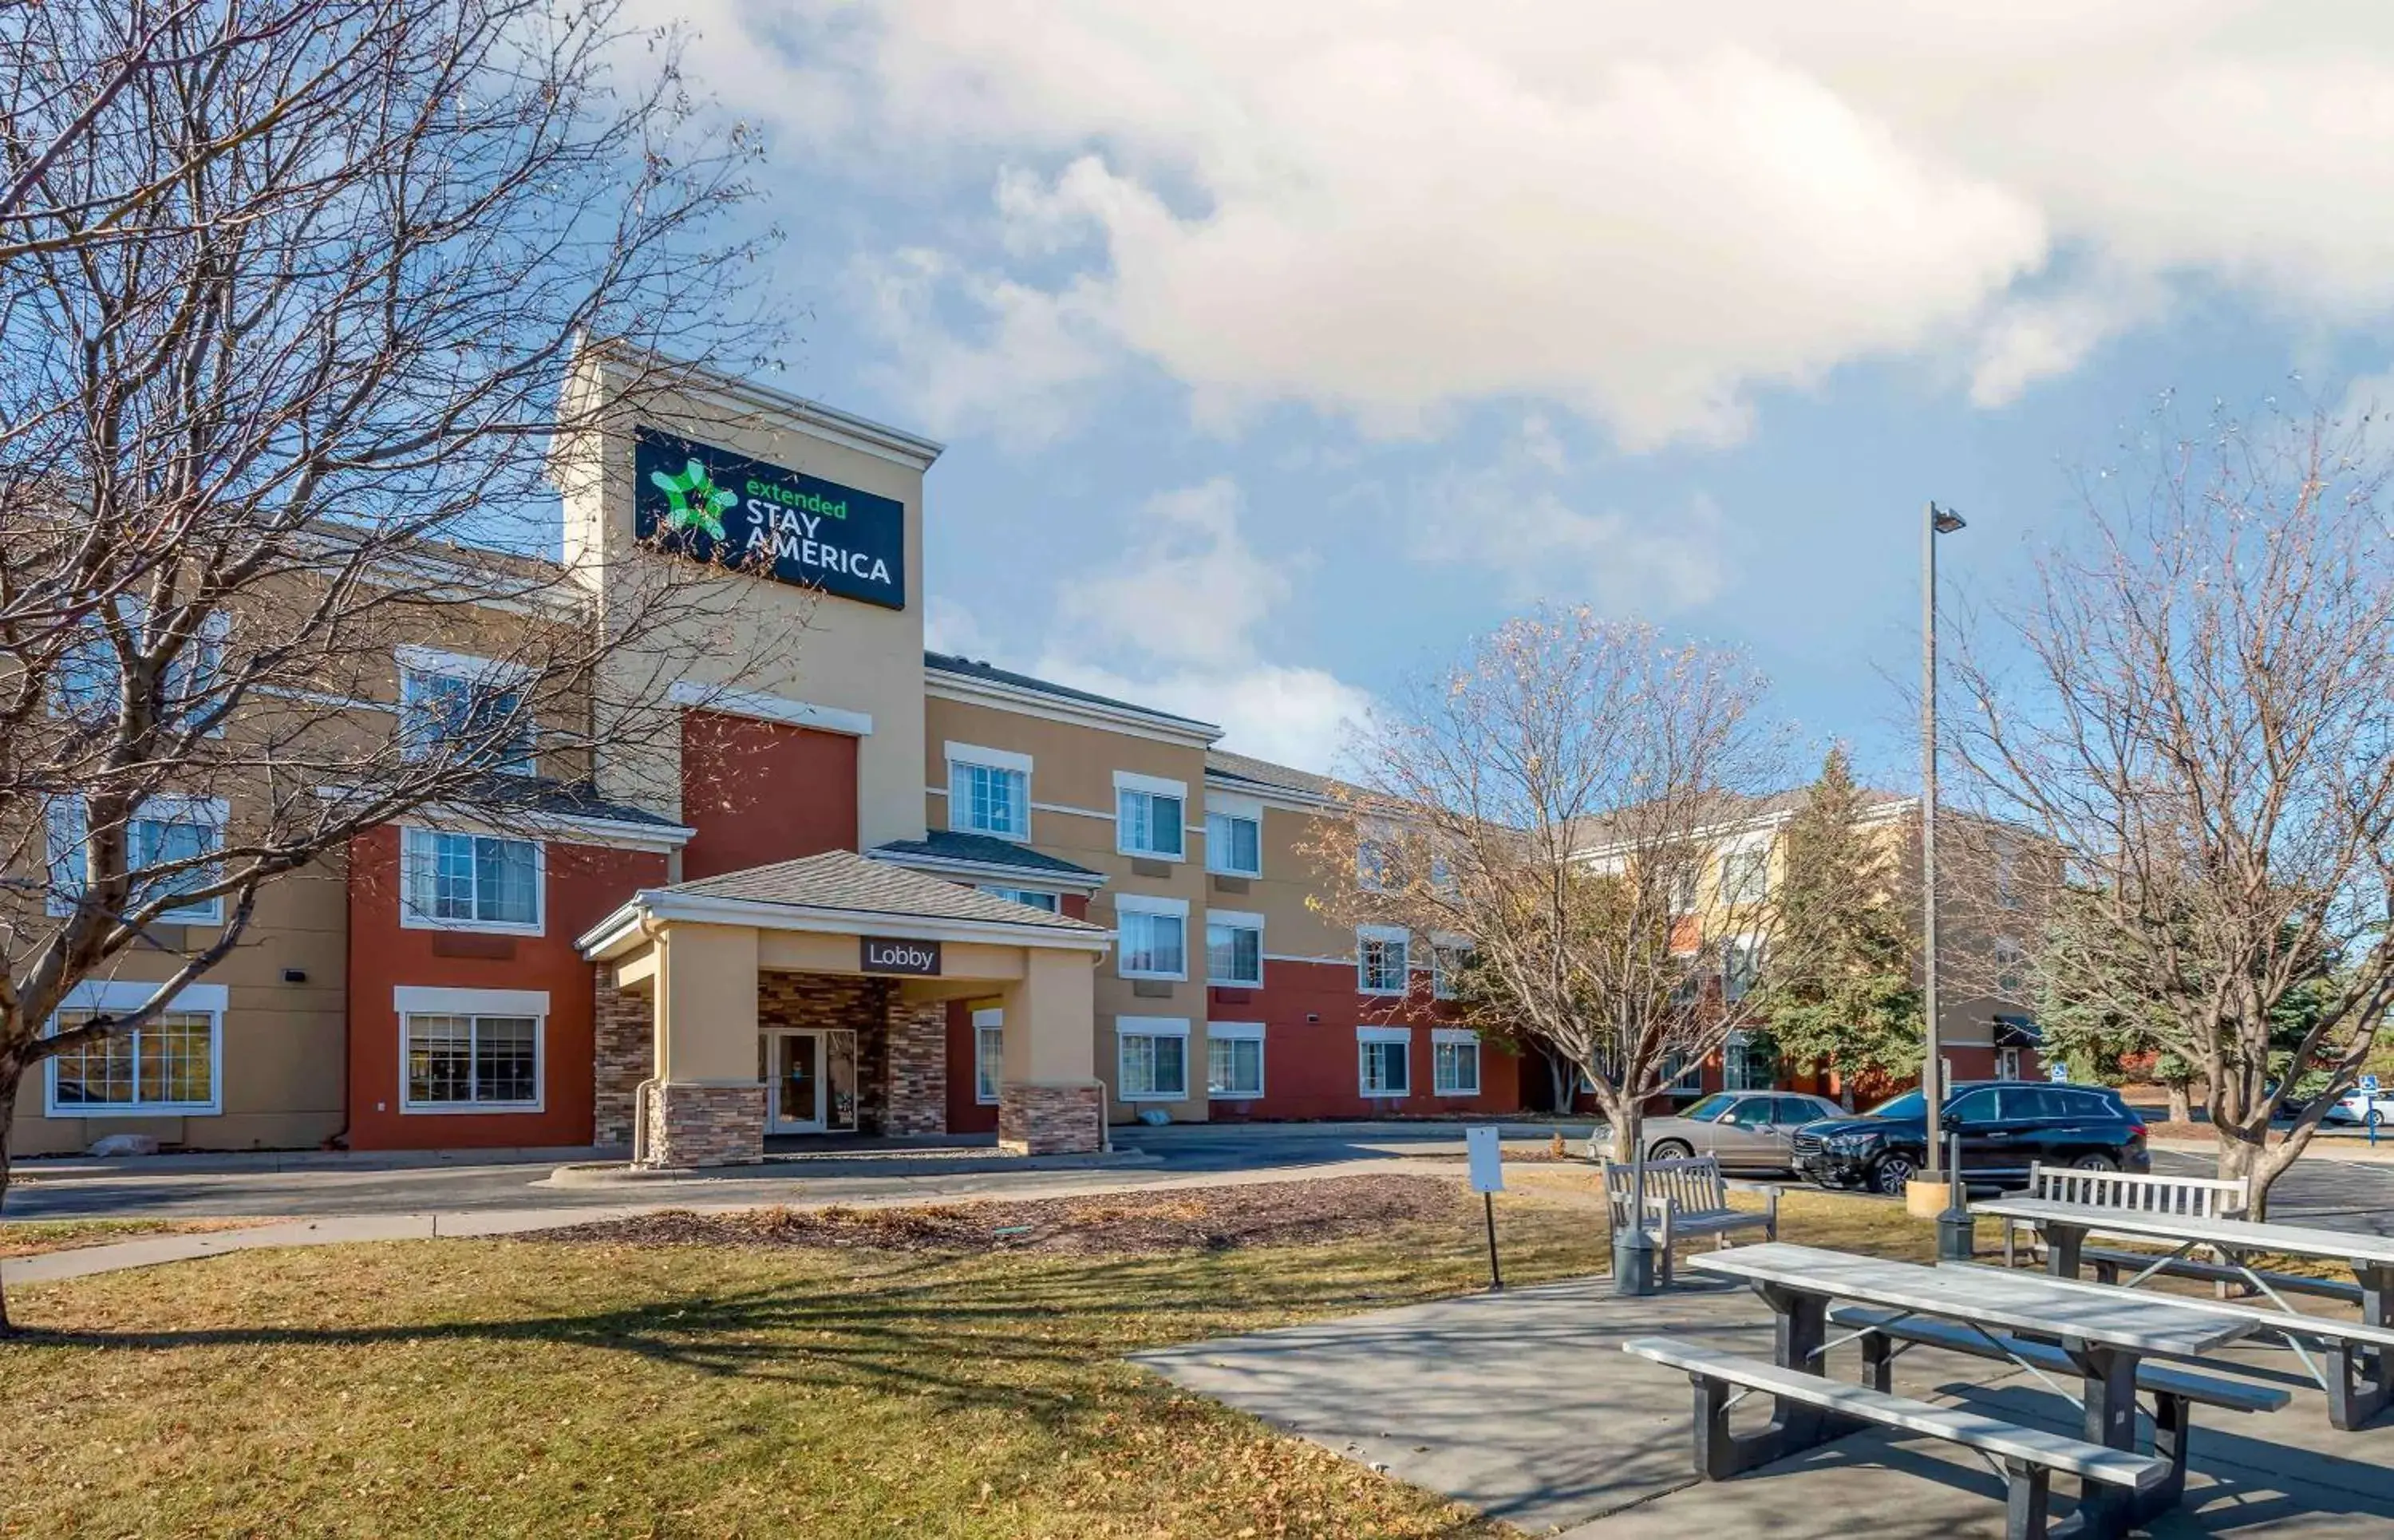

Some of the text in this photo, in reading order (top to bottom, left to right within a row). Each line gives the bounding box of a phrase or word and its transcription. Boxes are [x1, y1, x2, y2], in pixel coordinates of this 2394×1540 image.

[746, 480, 846, 519] extended
[746, 499, 821, 539] STAY
[746, 526, 891, 585] AMERICA
[870, 944, 934, 971] Lobby
